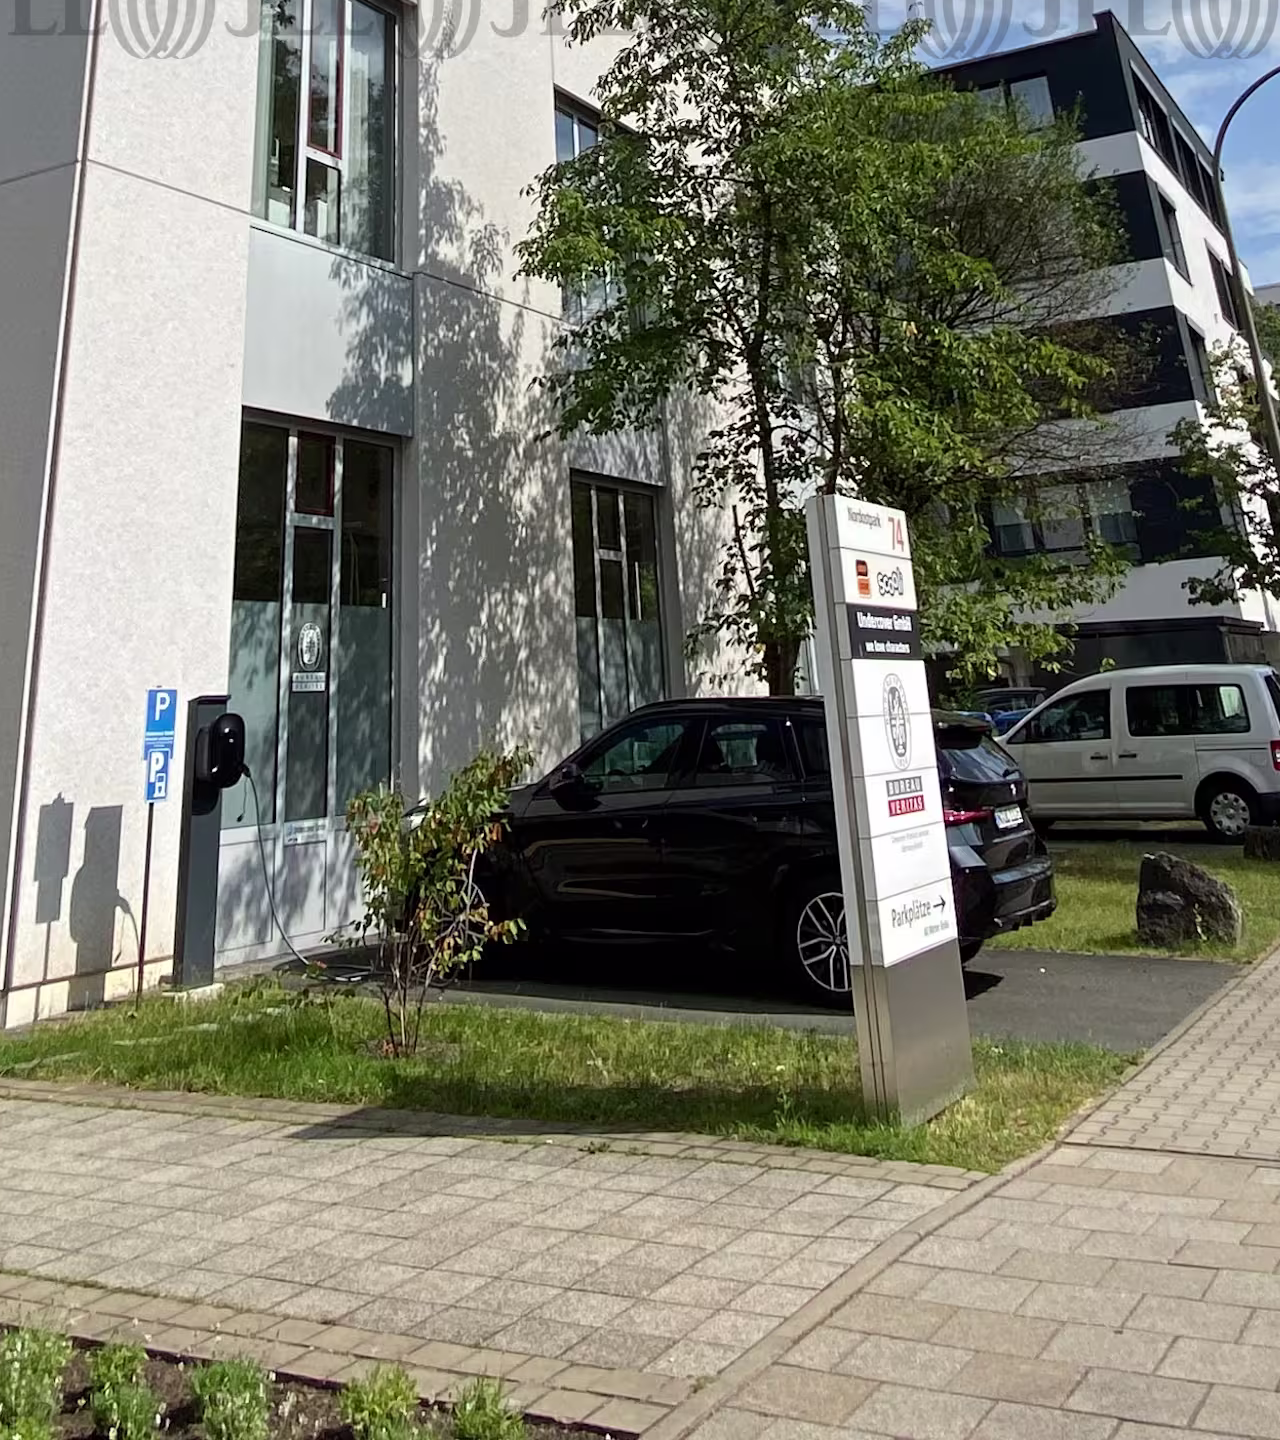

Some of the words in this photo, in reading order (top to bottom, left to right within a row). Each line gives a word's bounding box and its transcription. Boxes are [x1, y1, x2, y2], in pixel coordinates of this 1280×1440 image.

[888, 517, 904, 552] 74
[155, 692, 170, 721] P
[149, 752, 165, 783] P
[887, 777, 921, 795] BUREAU
[889, 796, 923, 814] VERITAS
[891, 899, 931, 928] Parkplätze
